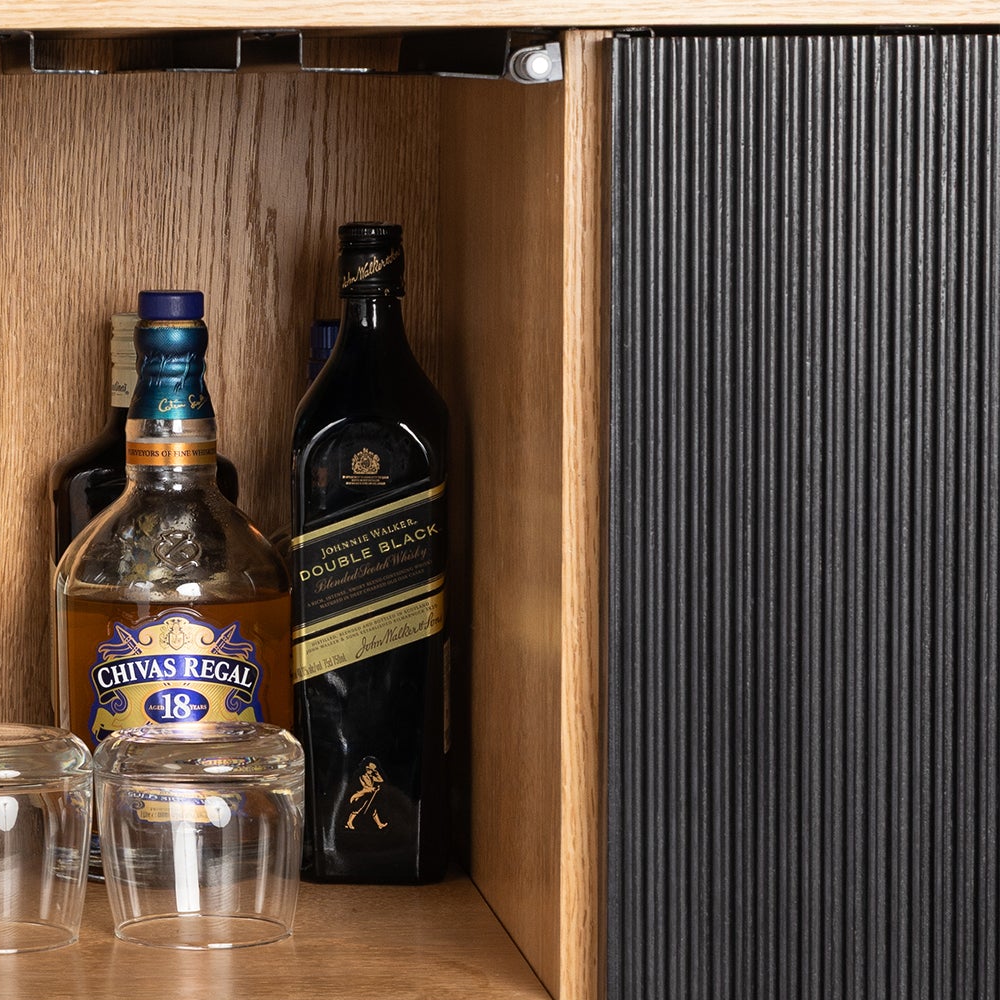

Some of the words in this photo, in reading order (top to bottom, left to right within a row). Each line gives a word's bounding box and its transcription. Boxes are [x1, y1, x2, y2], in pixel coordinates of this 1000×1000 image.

[173, 449, 192, 457] FINE
[300, 547, 373, 581] DOUBLE
[378, 523, 439, 554] BLACK
[321, 534, 369, 559] JOHNNIE
[313, 569, 359, 593] Blended
[358, 557, 389, 578] Scotch
[388, 546, 428, 568] Whisky
[355, 637, 383, 659] John
[382, 621, 419, 645] Walker
[97, 657, 177, 688] CHIVAS
[183, 657, 253, 688] REGAL
[148, 703, 165, 711] AGED
[161, 693, 191, 719] 18
[190, 703, 207, 711] YEARS
